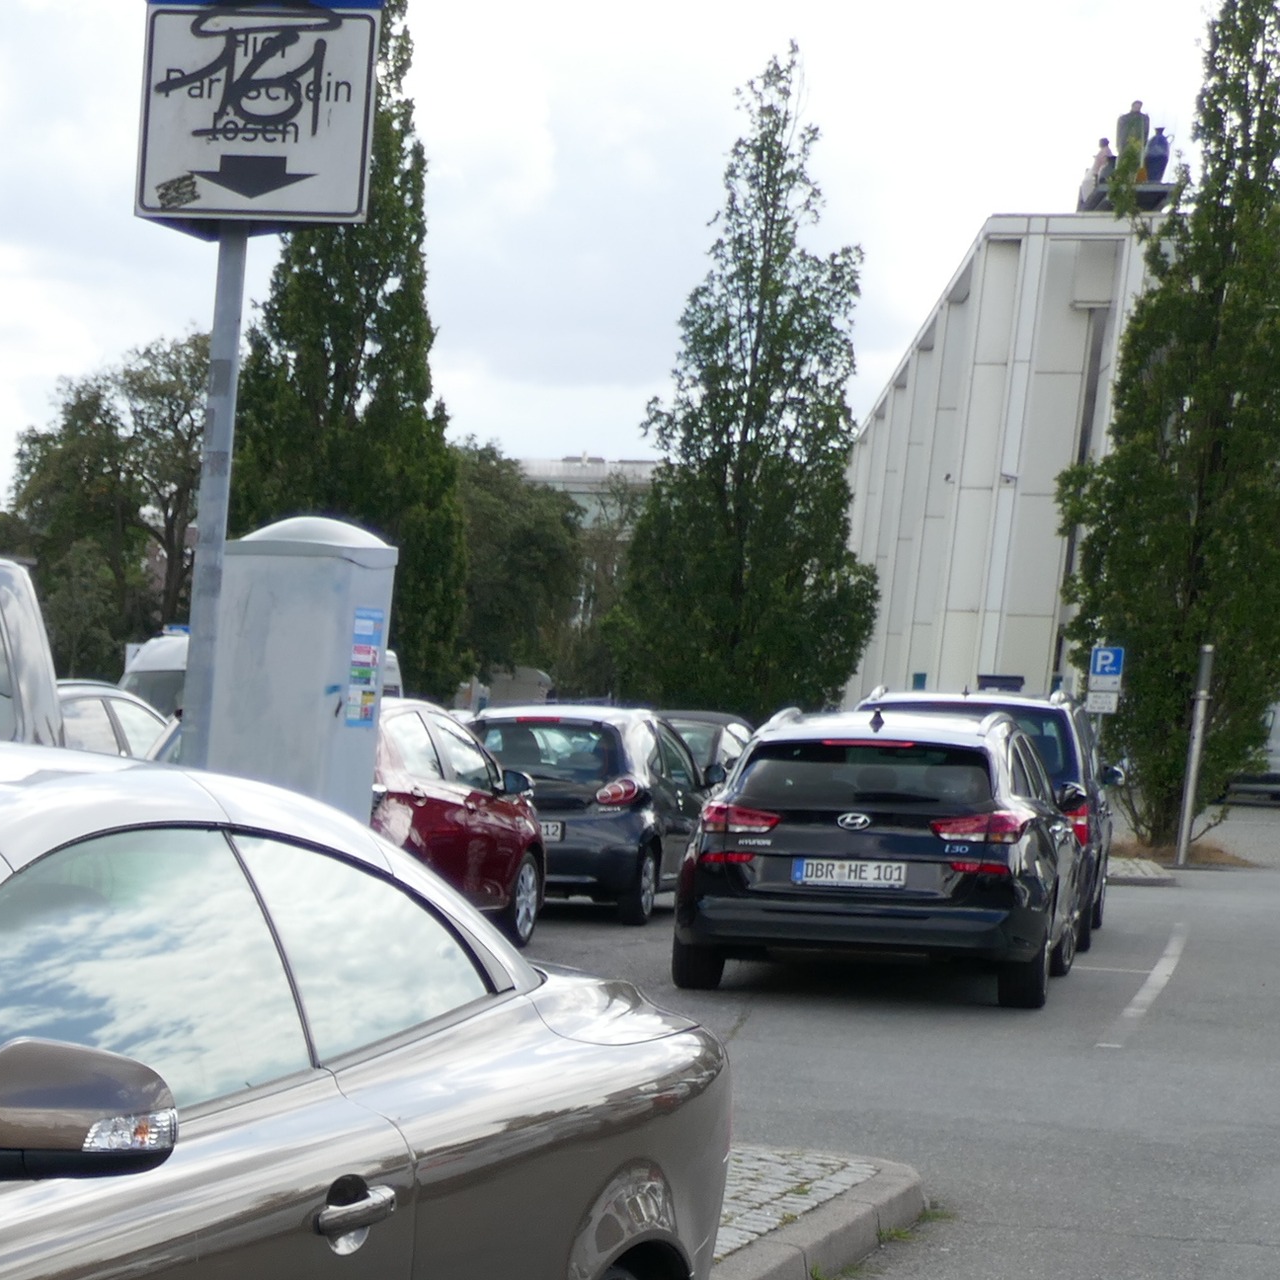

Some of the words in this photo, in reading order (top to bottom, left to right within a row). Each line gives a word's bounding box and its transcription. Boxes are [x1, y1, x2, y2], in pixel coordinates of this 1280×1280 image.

[164, 68, 352, 103] Parschein
[1096, 650, 1114, 672] P
[539, 824, 559, 836] 12
[805, 862, 835, 879] DBR
[848, 863, 868, 880] HE
[873, 865, 903, 882] 101
